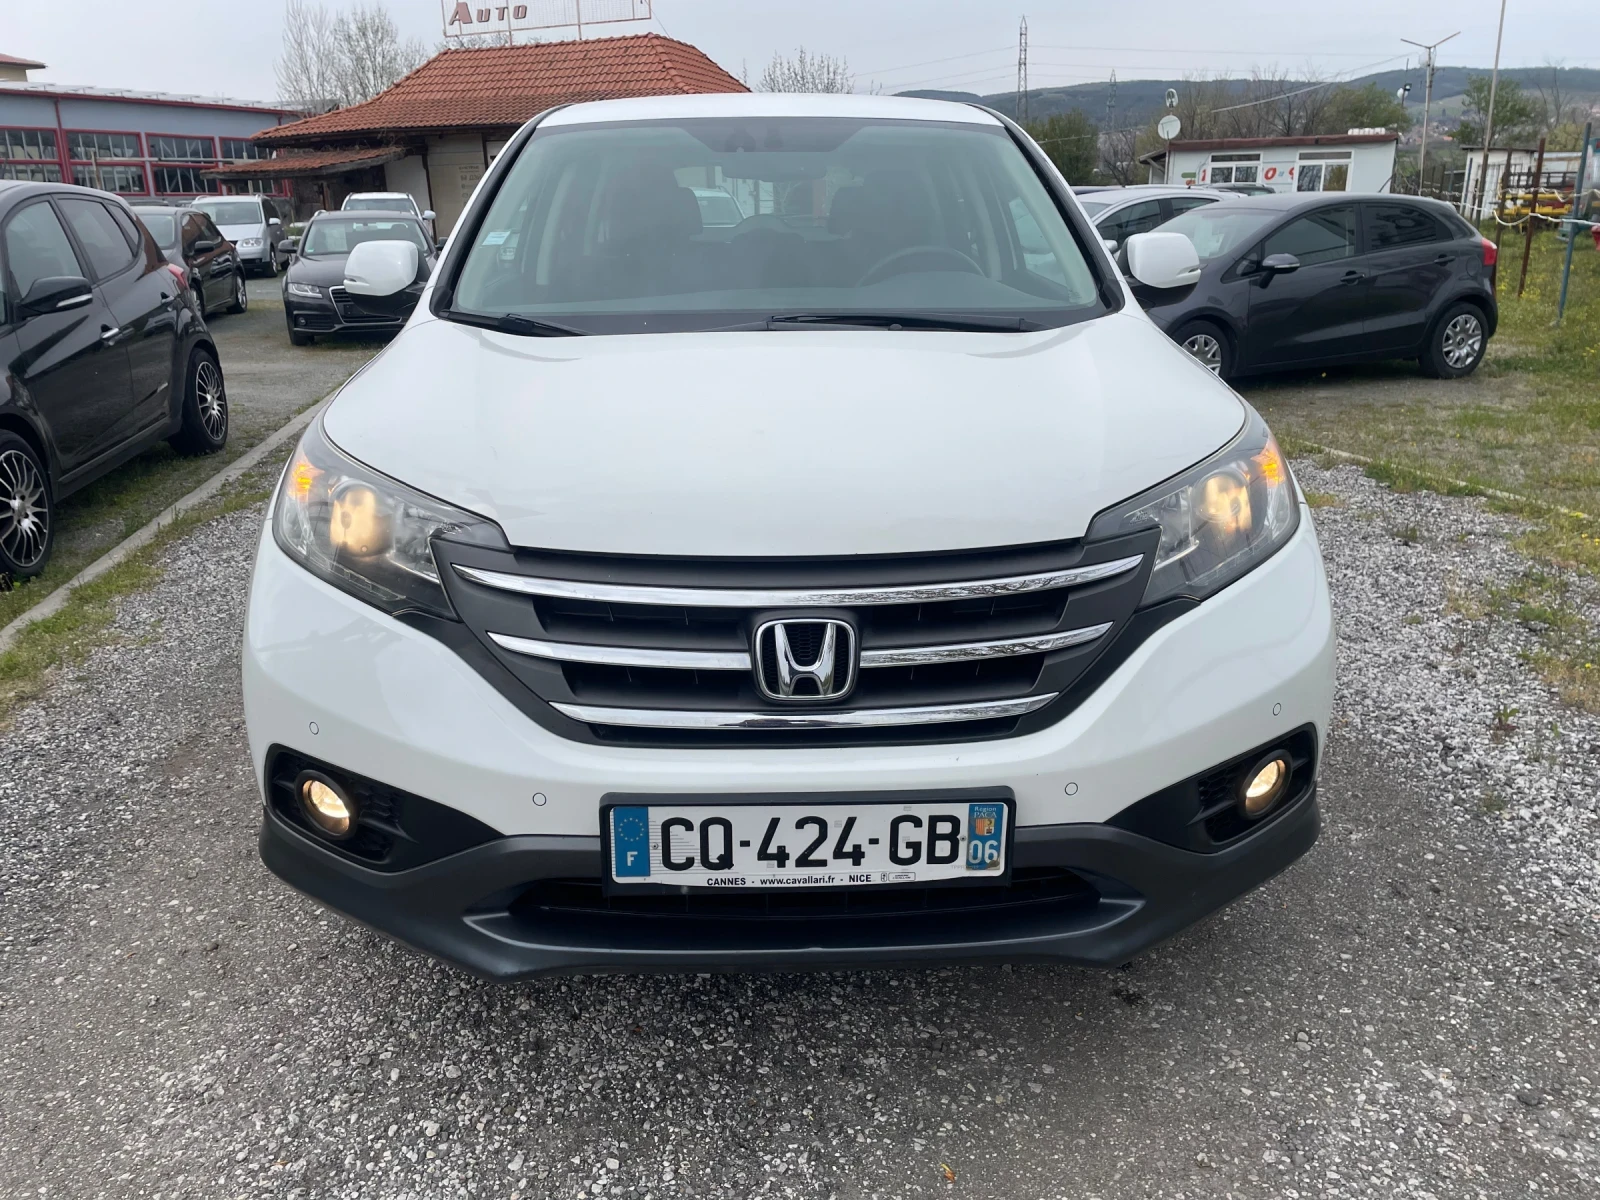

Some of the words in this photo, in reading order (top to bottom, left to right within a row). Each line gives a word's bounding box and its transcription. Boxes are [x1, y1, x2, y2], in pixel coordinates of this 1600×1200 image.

[661, 815, 961, 871] CQ-424-GB
[968, 840, 999, 864] 06
[626, 851, 638, 867] F
[706, 877, 746, 886] CANNES
[760, 875, 836, 885] www.cavallari.fr
[848, 874, 872, 883] NICE
